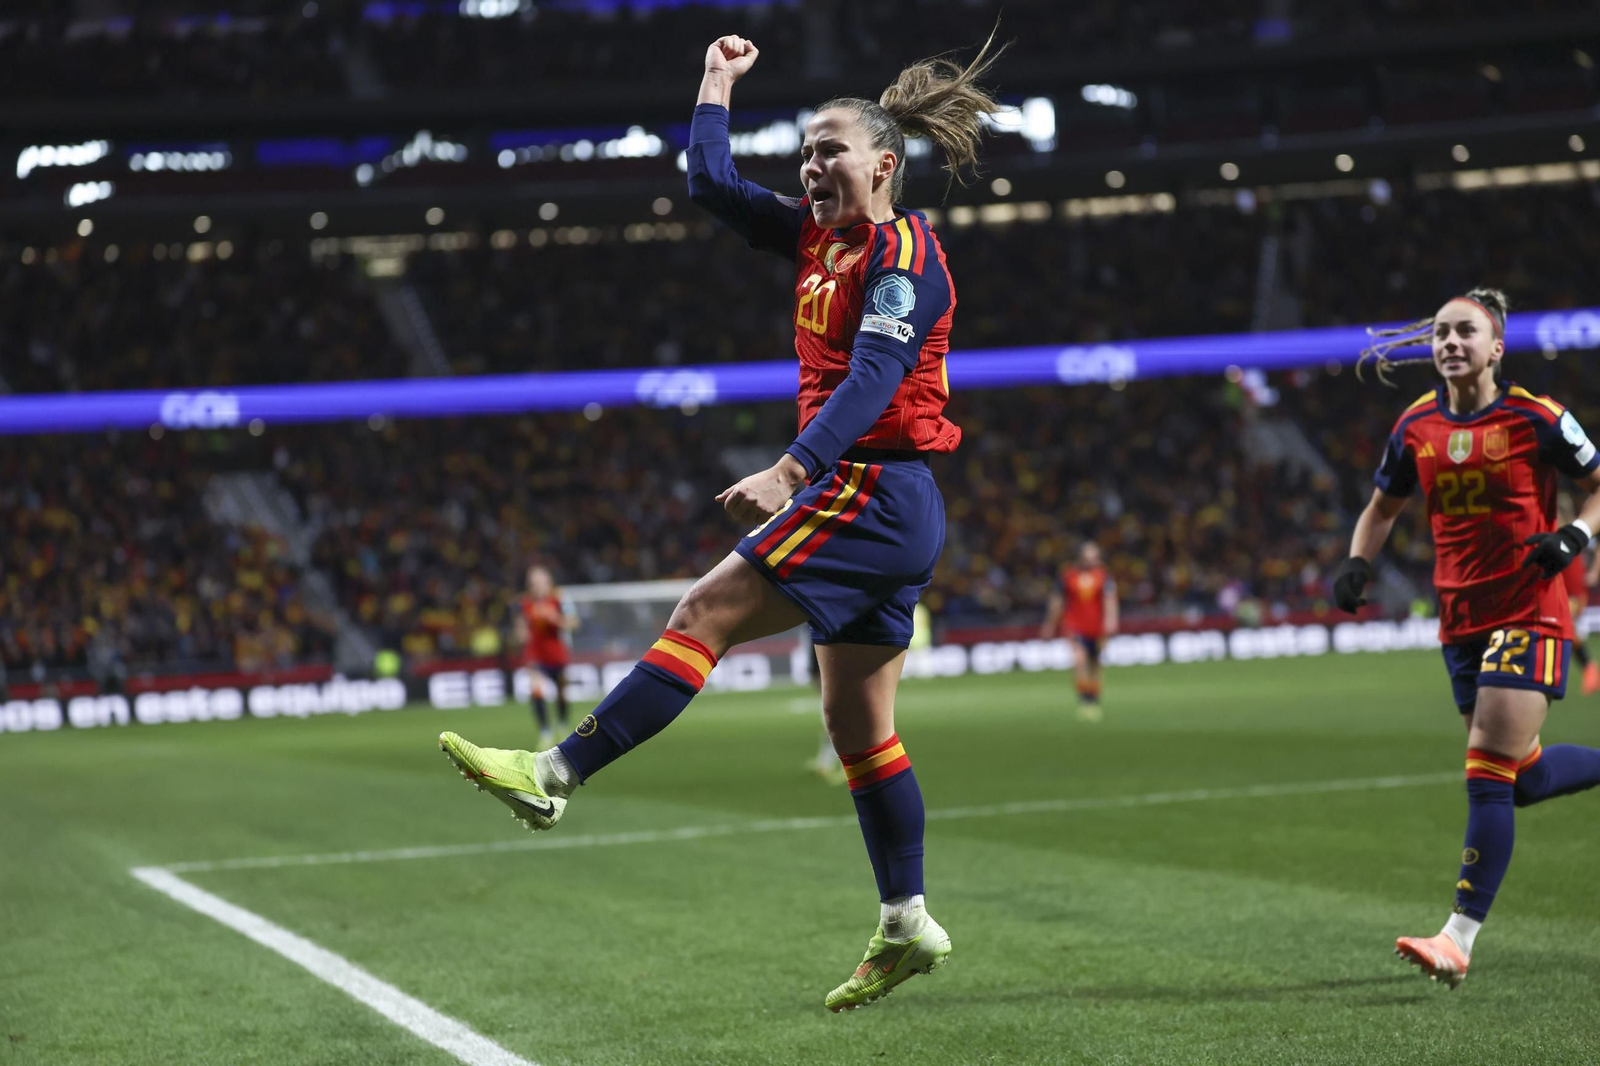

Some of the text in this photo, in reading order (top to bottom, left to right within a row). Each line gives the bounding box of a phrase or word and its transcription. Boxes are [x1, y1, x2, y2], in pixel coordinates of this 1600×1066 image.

[797, 273, 836, 335] 20
[1436, 470, 1491, 515] 22
[1481, 629, 1530, 675] 22
